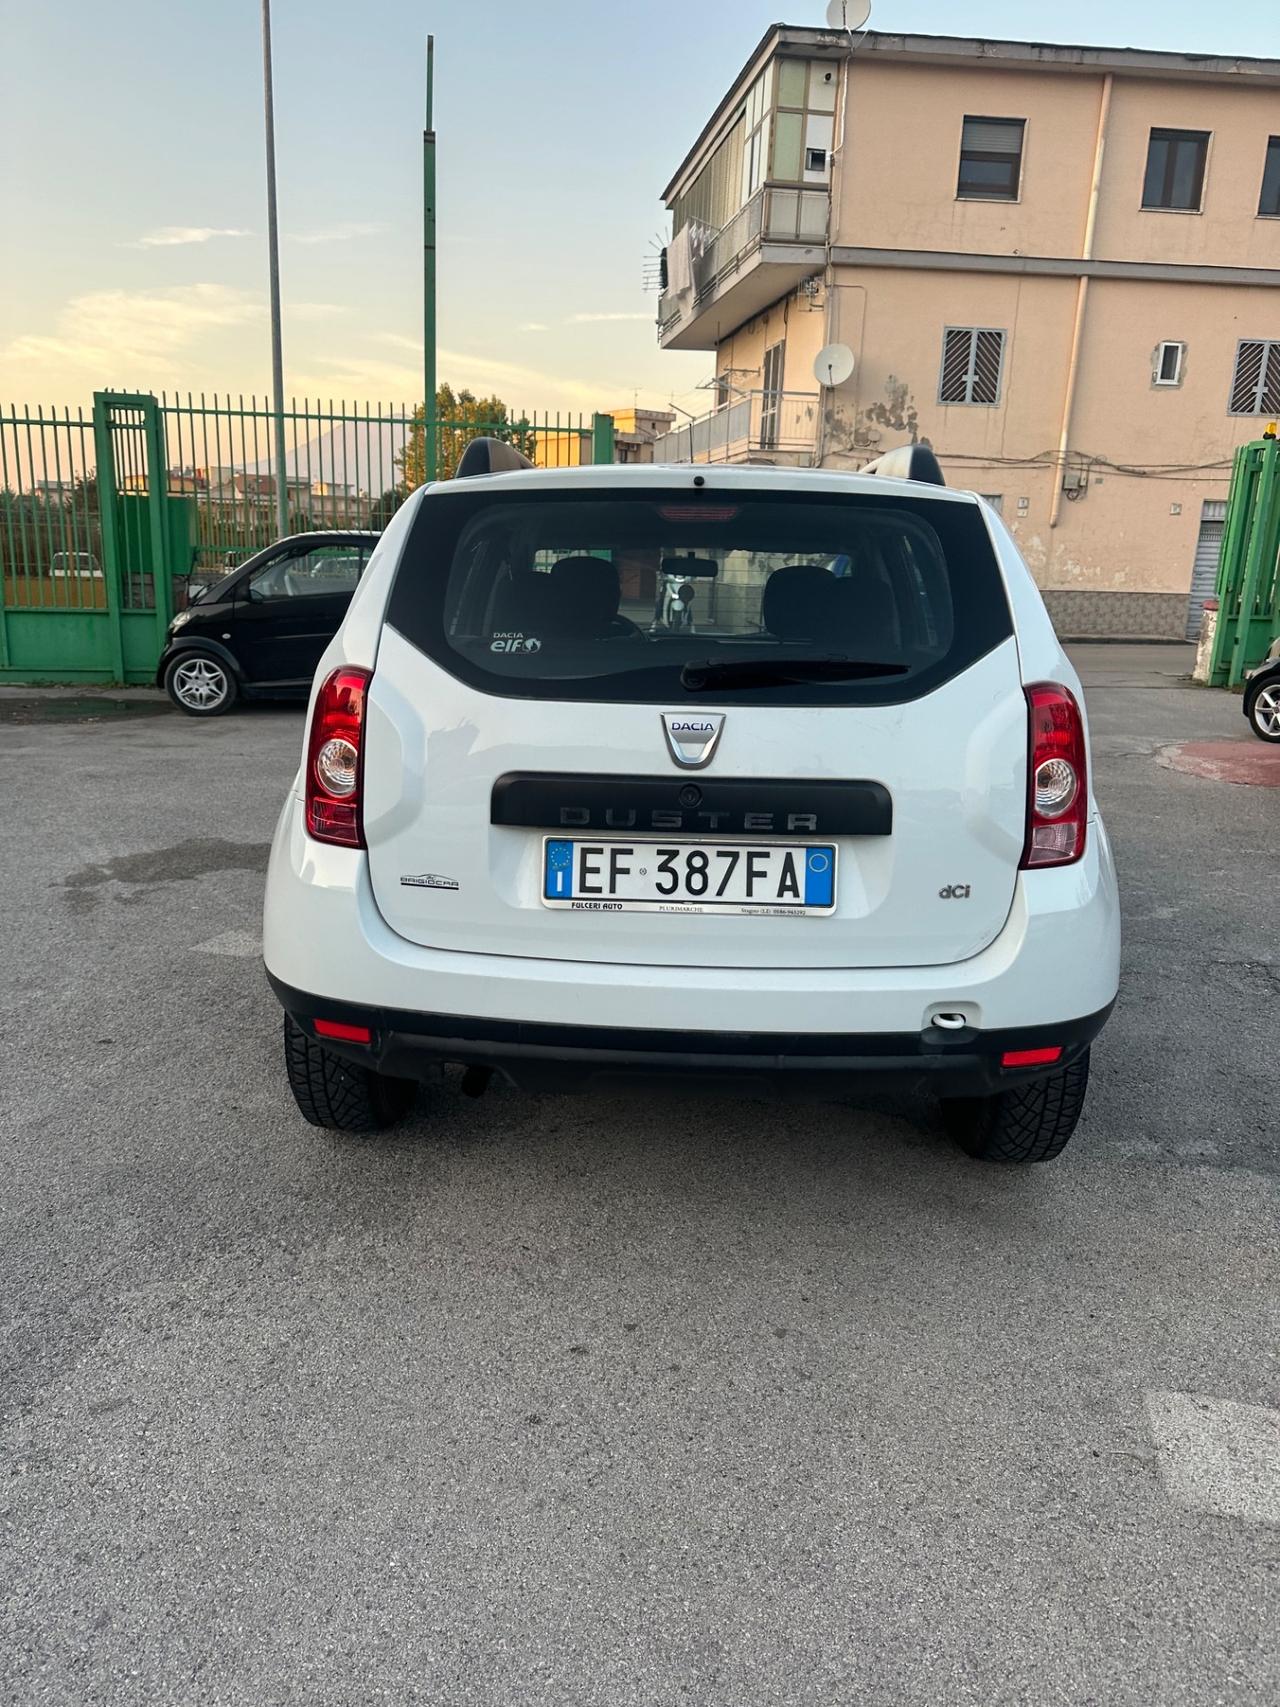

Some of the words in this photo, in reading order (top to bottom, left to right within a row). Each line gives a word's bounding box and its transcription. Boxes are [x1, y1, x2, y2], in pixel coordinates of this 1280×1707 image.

[671, 722, 714, 731] DACIA
[560, 807, 818, 831] DUSTER
[579, 847, 634, 894] EF
[655, 849, 801, 898] 387FA
[938, 884, 971, 899] dCi
